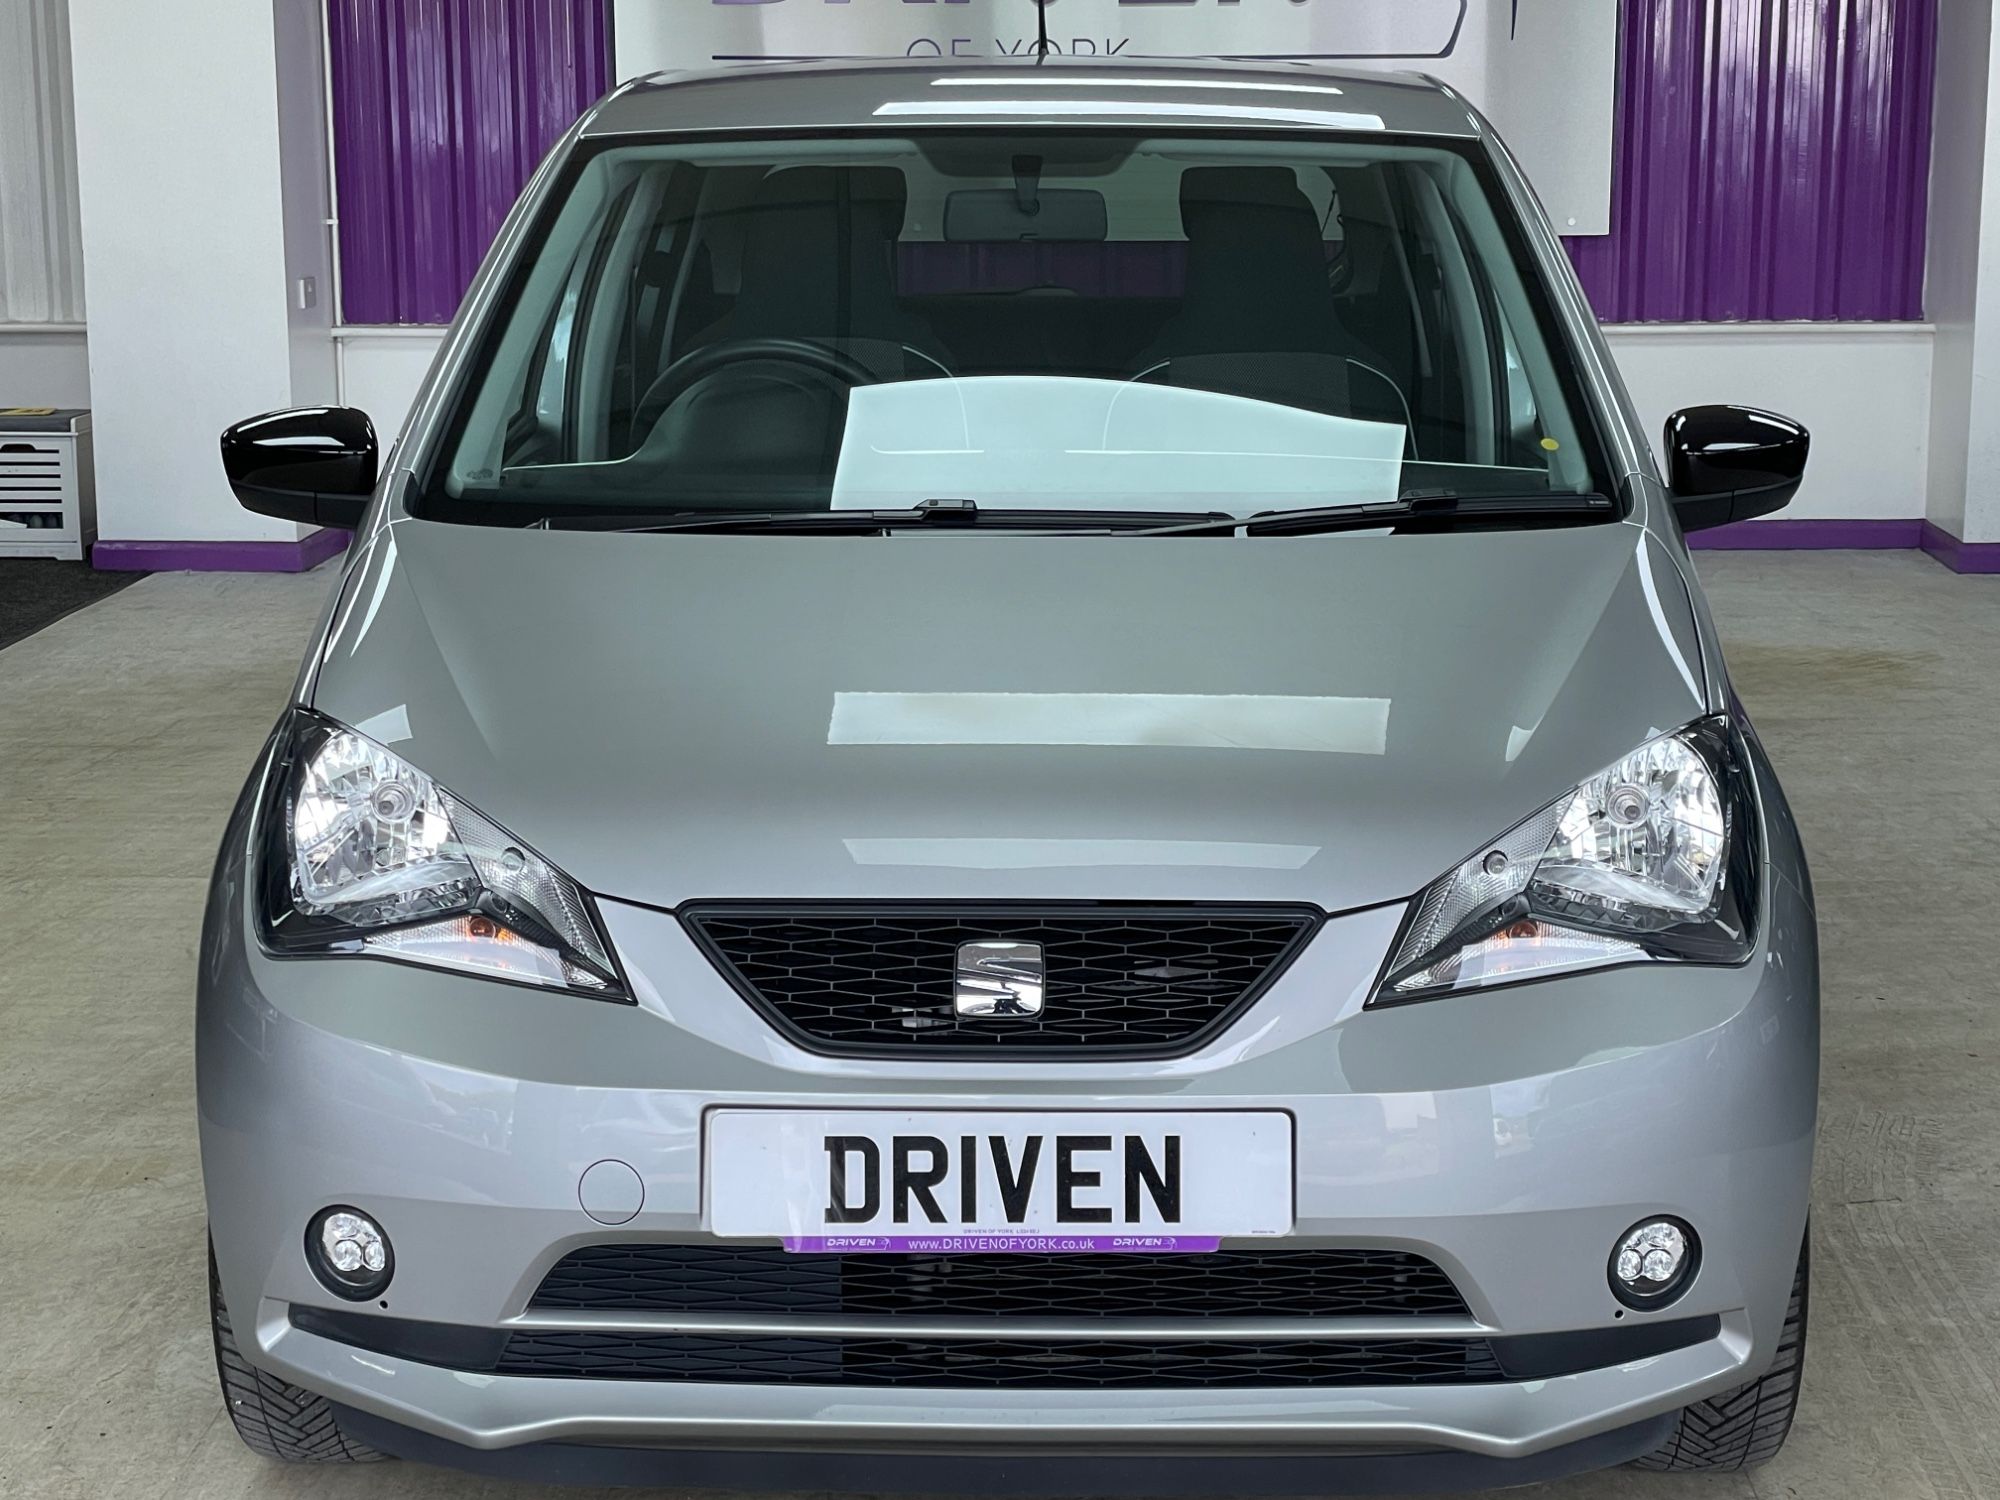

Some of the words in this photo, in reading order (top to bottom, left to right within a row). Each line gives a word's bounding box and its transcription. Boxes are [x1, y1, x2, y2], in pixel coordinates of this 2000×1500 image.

[824, 1135, 1181, 1224] DRIVEN
[826, 1238, 876, 1247] DRIVEN
[908, 1237, 1096, 1250] www.DRIVENOFYORK.co.uk
[1112, 1237, 1162, 1246] DRIVEN
